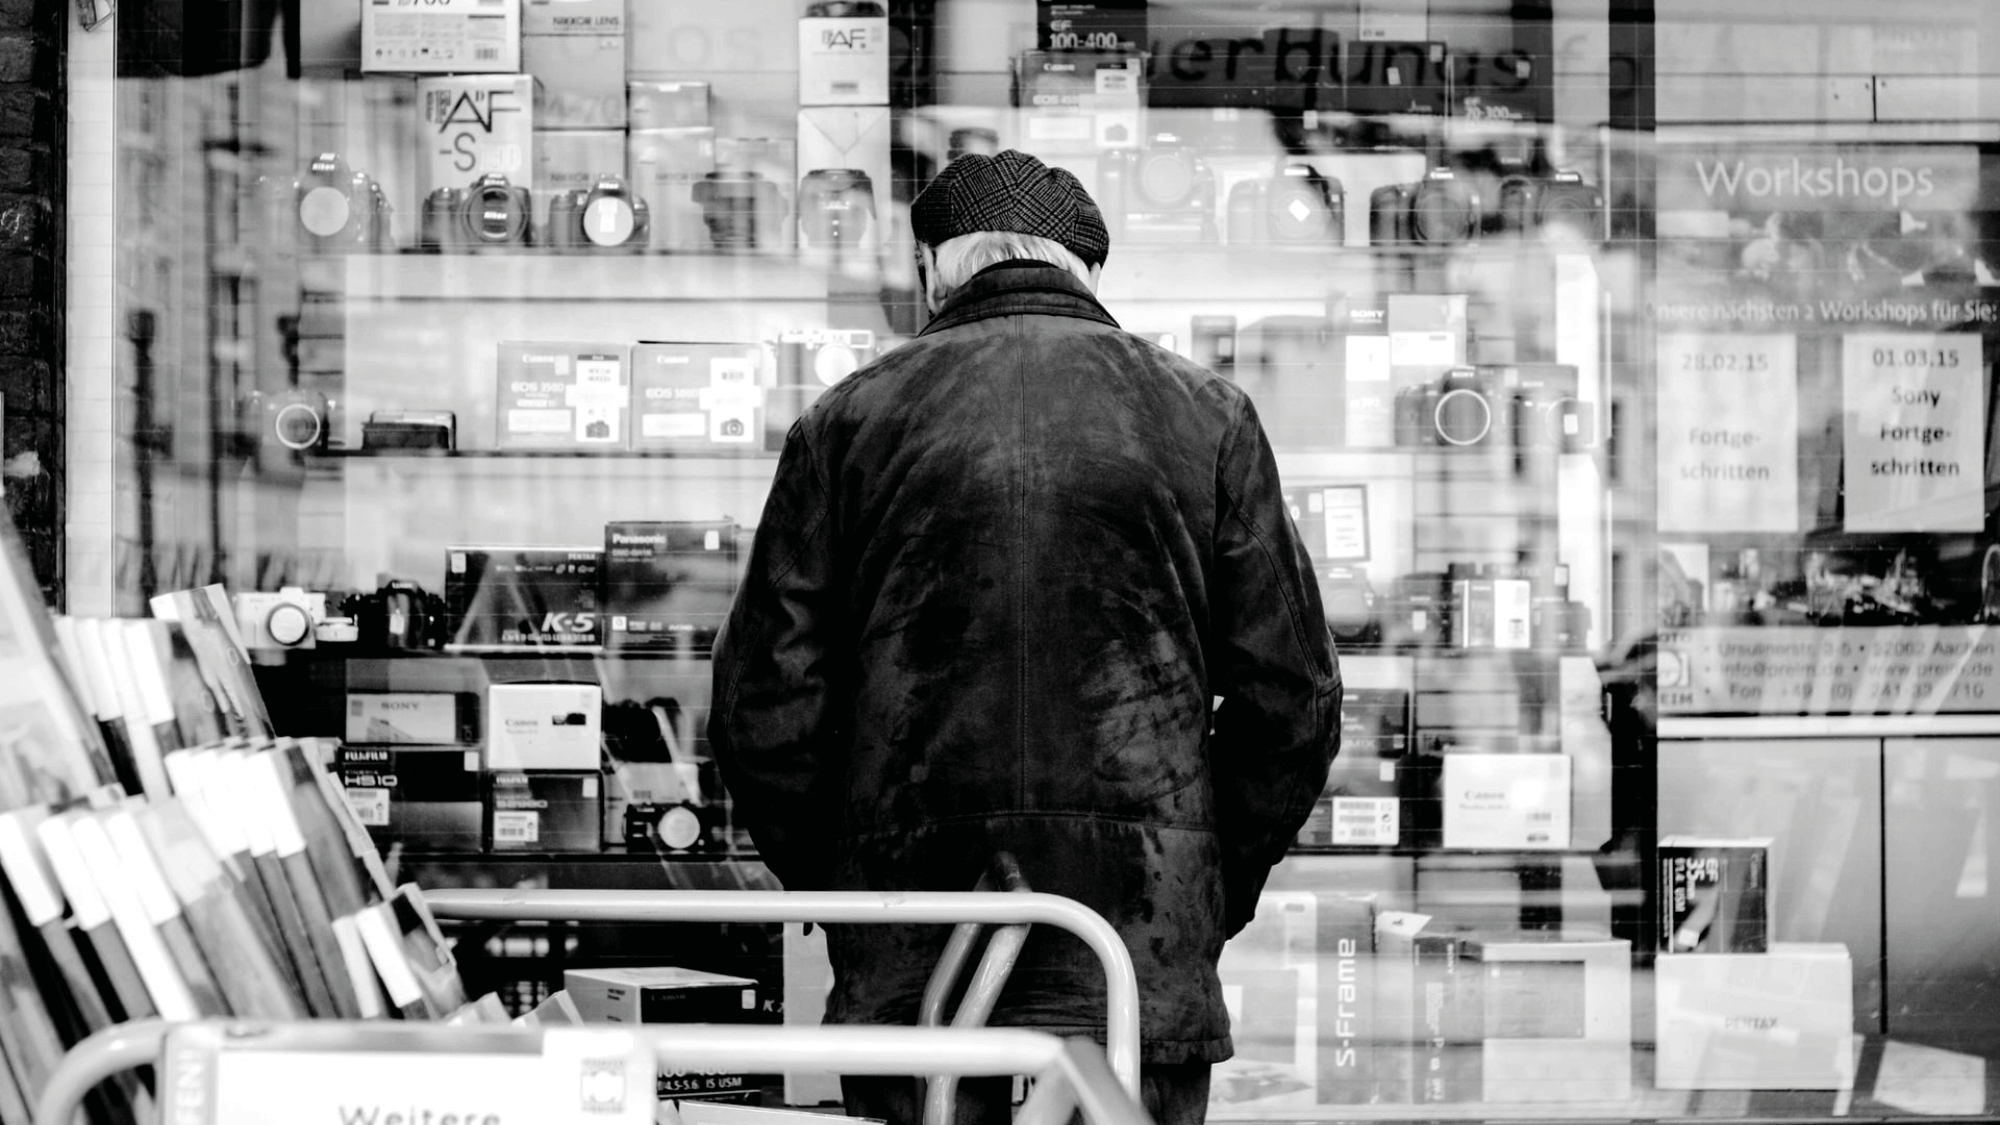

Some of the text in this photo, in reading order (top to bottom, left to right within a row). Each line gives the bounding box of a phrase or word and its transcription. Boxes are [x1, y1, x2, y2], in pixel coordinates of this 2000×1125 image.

[553, 16, 619, 25] NIKKOR LENS
[1050, 20, 1072, 31] EF
[1043, 63, 1075, 71] Canon
[1696, 156, 1935, 207] Workshops
[1819, 299, 1928, 327] Workshops
[1964, 299, 1997, 322] Sie:
[1681, 352, 1769, 372] 28.02.15
[1872, 348, 1960, 369] 01.03.15
[1892, 386, 1941, 409] Sony
[1689, 427, 1761, 450] Fortge-
[1880, 423, 1952, 446] Fortge-
[1680, 461, 1770, 481] schritten
[1870, 458, 1960, 478] schritten
[612, 533, 667, 545] Panasonic
[541, 611, 596, 633] K-5
[380, 701, 420, 711] SONY
[505, 718, 538, 727] Canon
[344, 775, 398, 787] HS10
[1464, 790, 1504, 800] Canon
[1705, 858, 1719, 882] EF
[1336, 938, 1356, 1068] S-Frame
[1724, 1016, 1778, 1030] PENTAX
[719, 1077, 741, 1088] USM
[338, 1104, 501, 1125] Weitere
